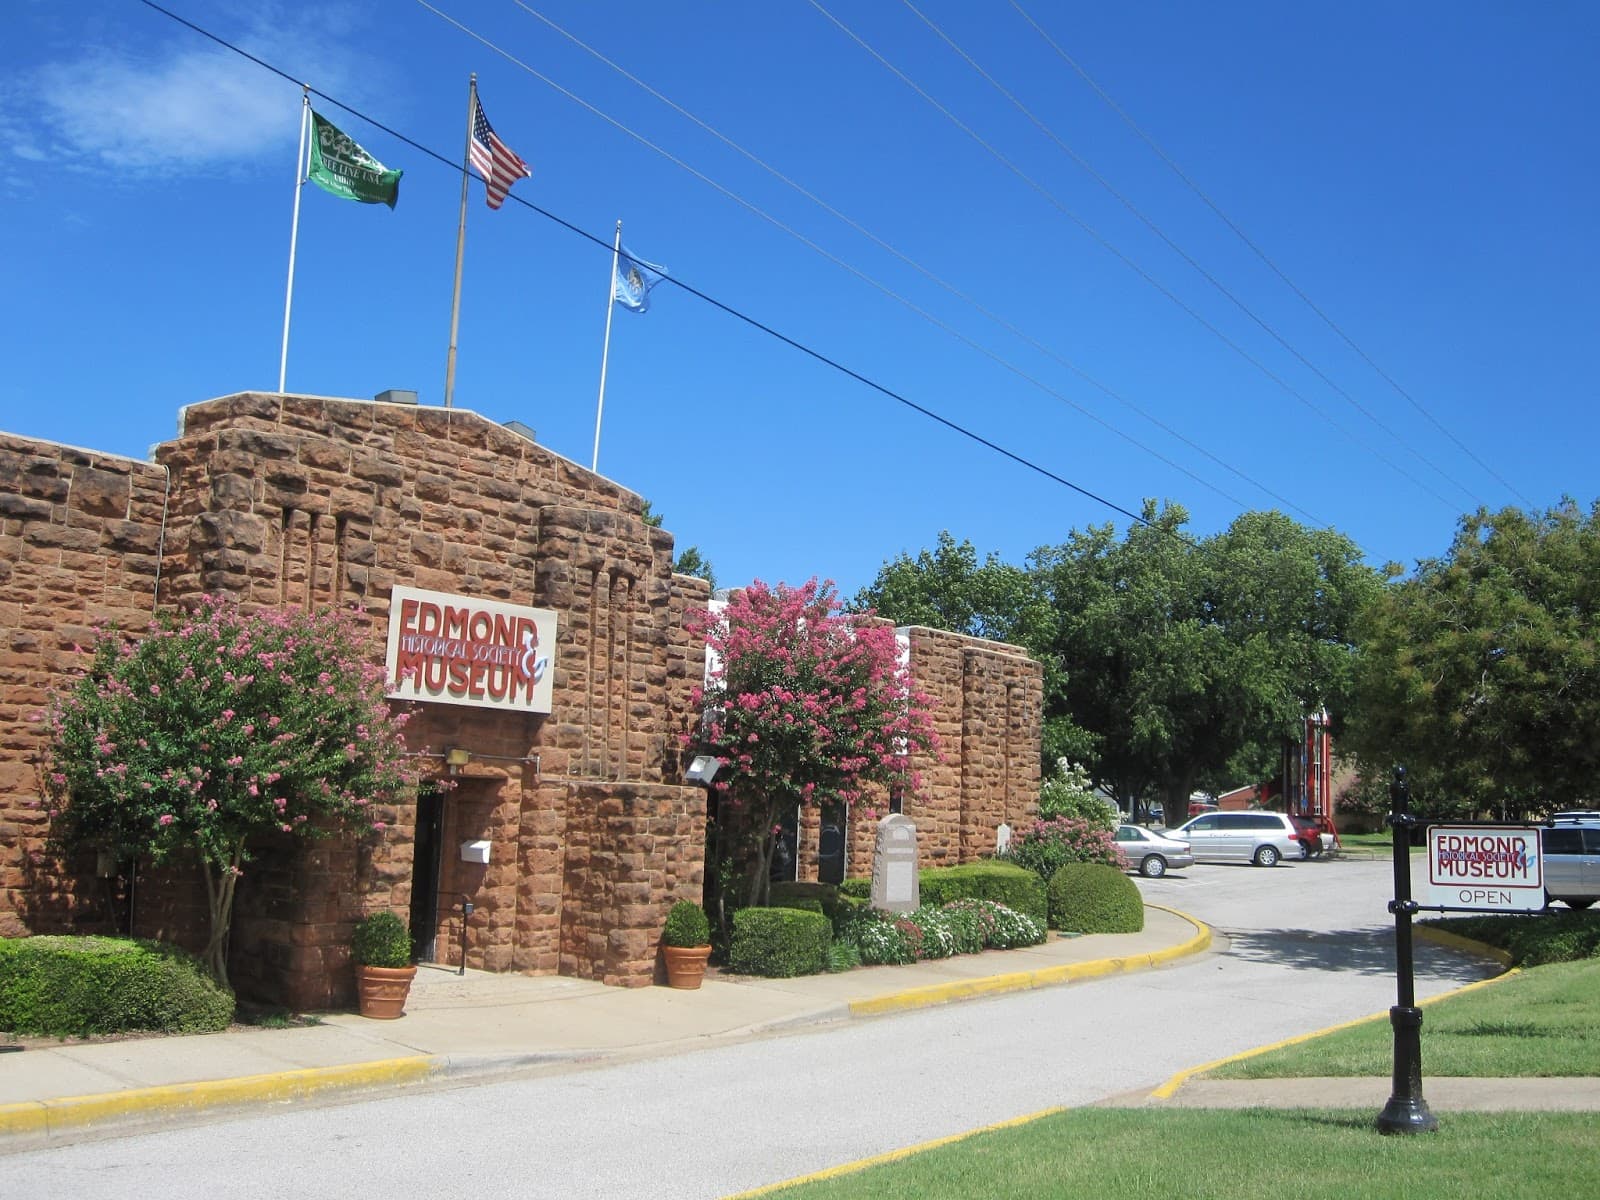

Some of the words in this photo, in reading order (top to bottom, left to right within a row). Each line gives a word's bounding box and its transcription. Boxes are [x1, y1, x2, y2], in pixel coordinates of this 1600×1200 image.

[339, 164, 360, 179] LINE
[363, 169, 379, 185] USA
[401, 599, 539, 649] EDMOND
[402, 634, 467, 659] HISTORICAL
[472, 643, 522, 666] SOCIETY
[396, 652, 537, 700] MUSEUM
[1438, 836, 1526, 853] EDMOND
[1438, 857, 1527, 879] MUSEUM
[1459, 890, 1511, 904] OPEN
